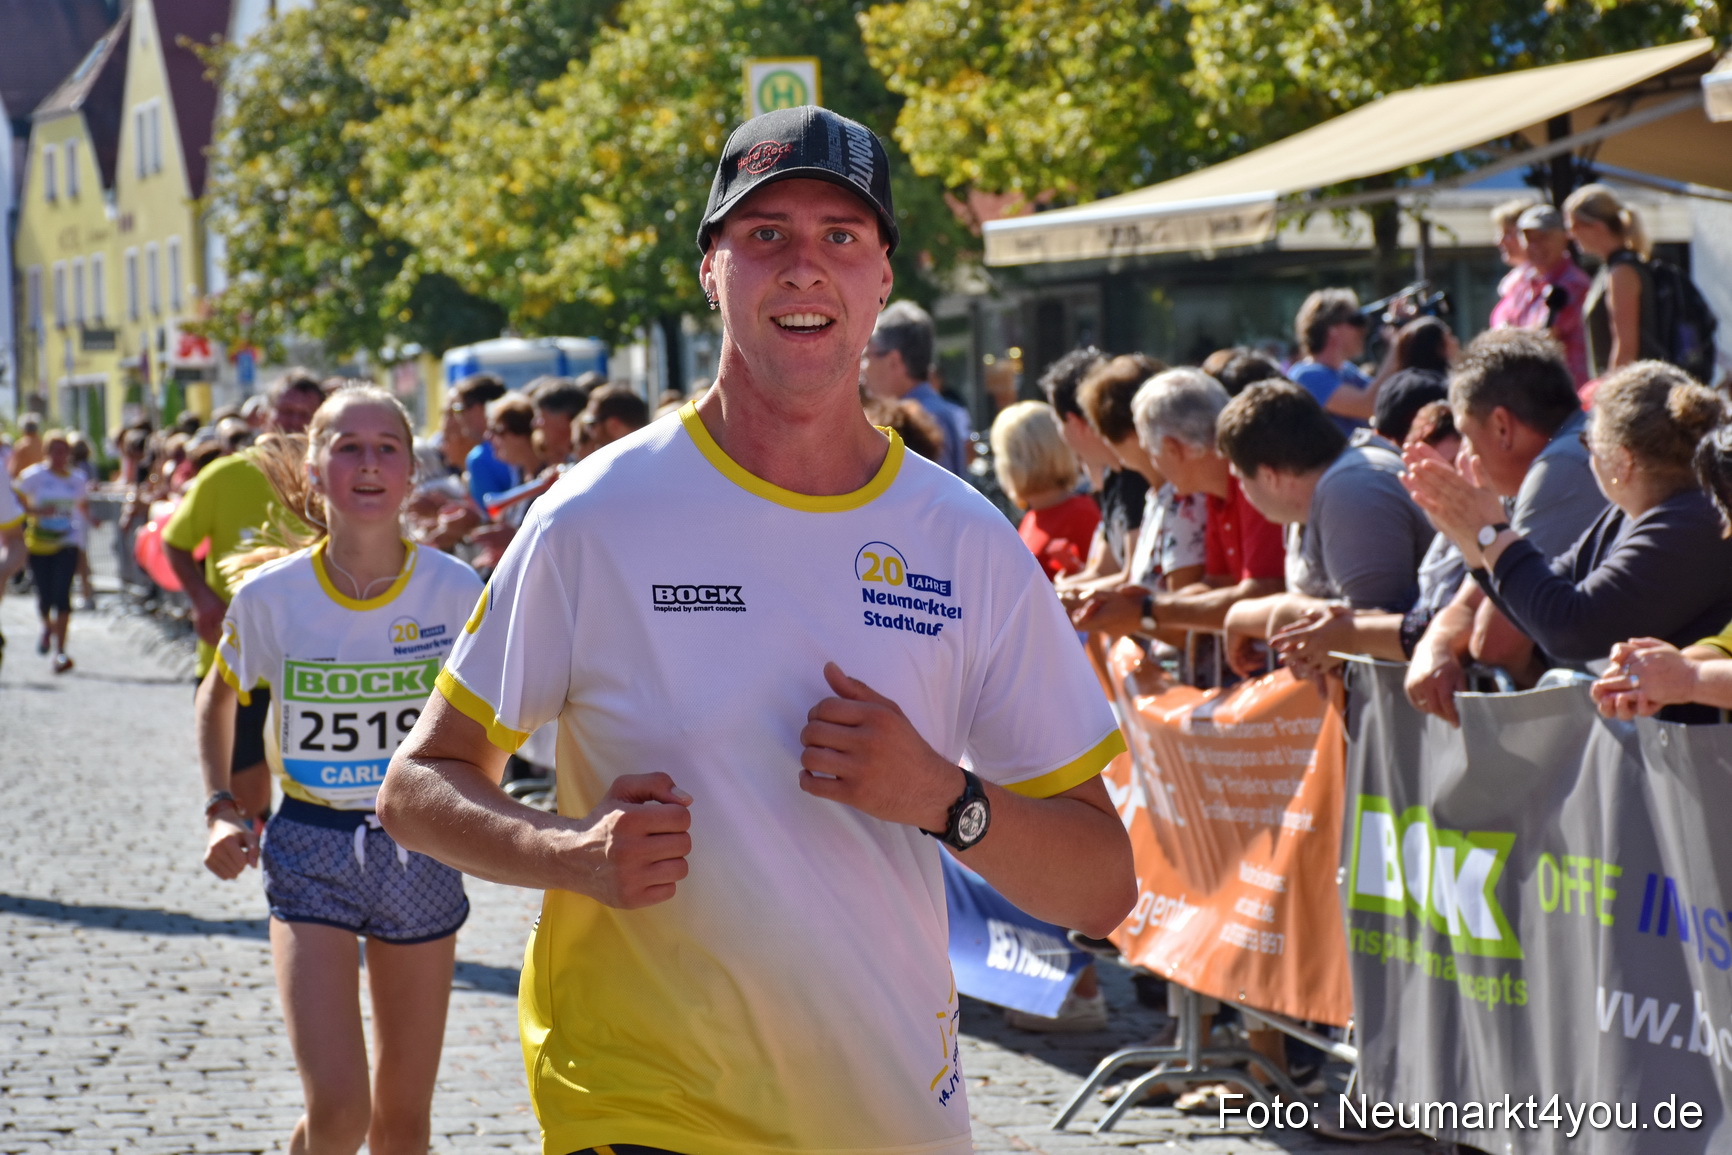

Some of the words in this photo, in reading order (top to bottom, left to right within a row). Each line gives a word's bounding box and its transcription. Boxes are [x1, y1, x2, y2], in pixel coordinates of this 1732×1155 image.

[861, 551, 905, 587] 20
[911, 576, 948, 594] JAHRE
[652, 584, 746, 605] BOCK
[683, 605, 692, 613] by
[715, 606, 747, 614] concepts
[393, 622, 419, 643] 20
[863, 610, 944, 640] Stadtlauf
[297, 667, 424, 699] BOCK
